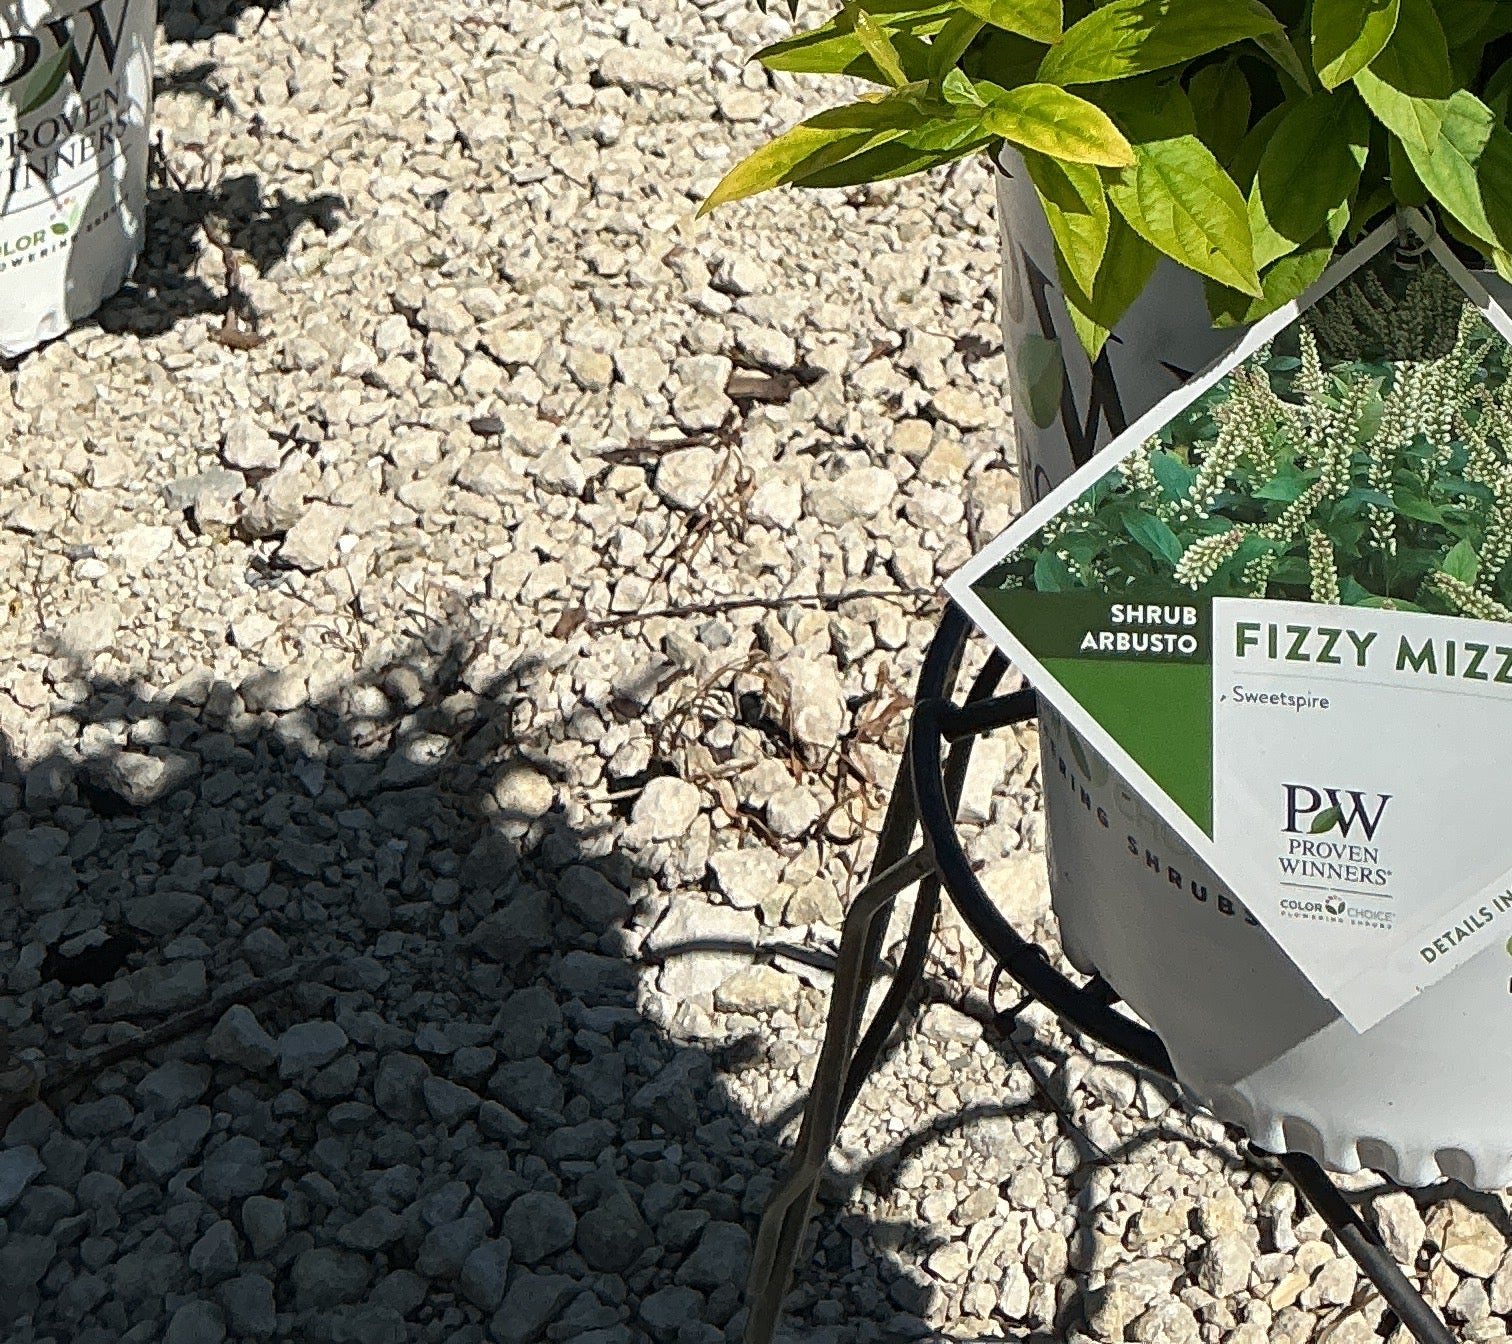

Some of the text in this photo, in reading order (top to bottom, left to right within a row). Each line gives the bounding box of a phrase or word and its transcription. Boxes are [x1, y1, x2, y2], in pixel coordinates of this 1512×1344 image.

[0, 80, 120, 158] ROVEN
[3, 114, 128, 197] INNERS
[0, 229, 46, 257] LOR
[1110, 604, 1198, 625] SHRUB
[1079, 630, 1198, 654] ARBUSTO
[1235, 621, 1378, 667] FIZZY
[1232, 685, 1331, 710] Sweetspire
[1281, 783, 1393, 841] PW
[1288, 838, 1379, 864] PROVEN
[1280, 899, 1322, 912] COLOR
[1419, 906, 1494, 965] DETAILS
